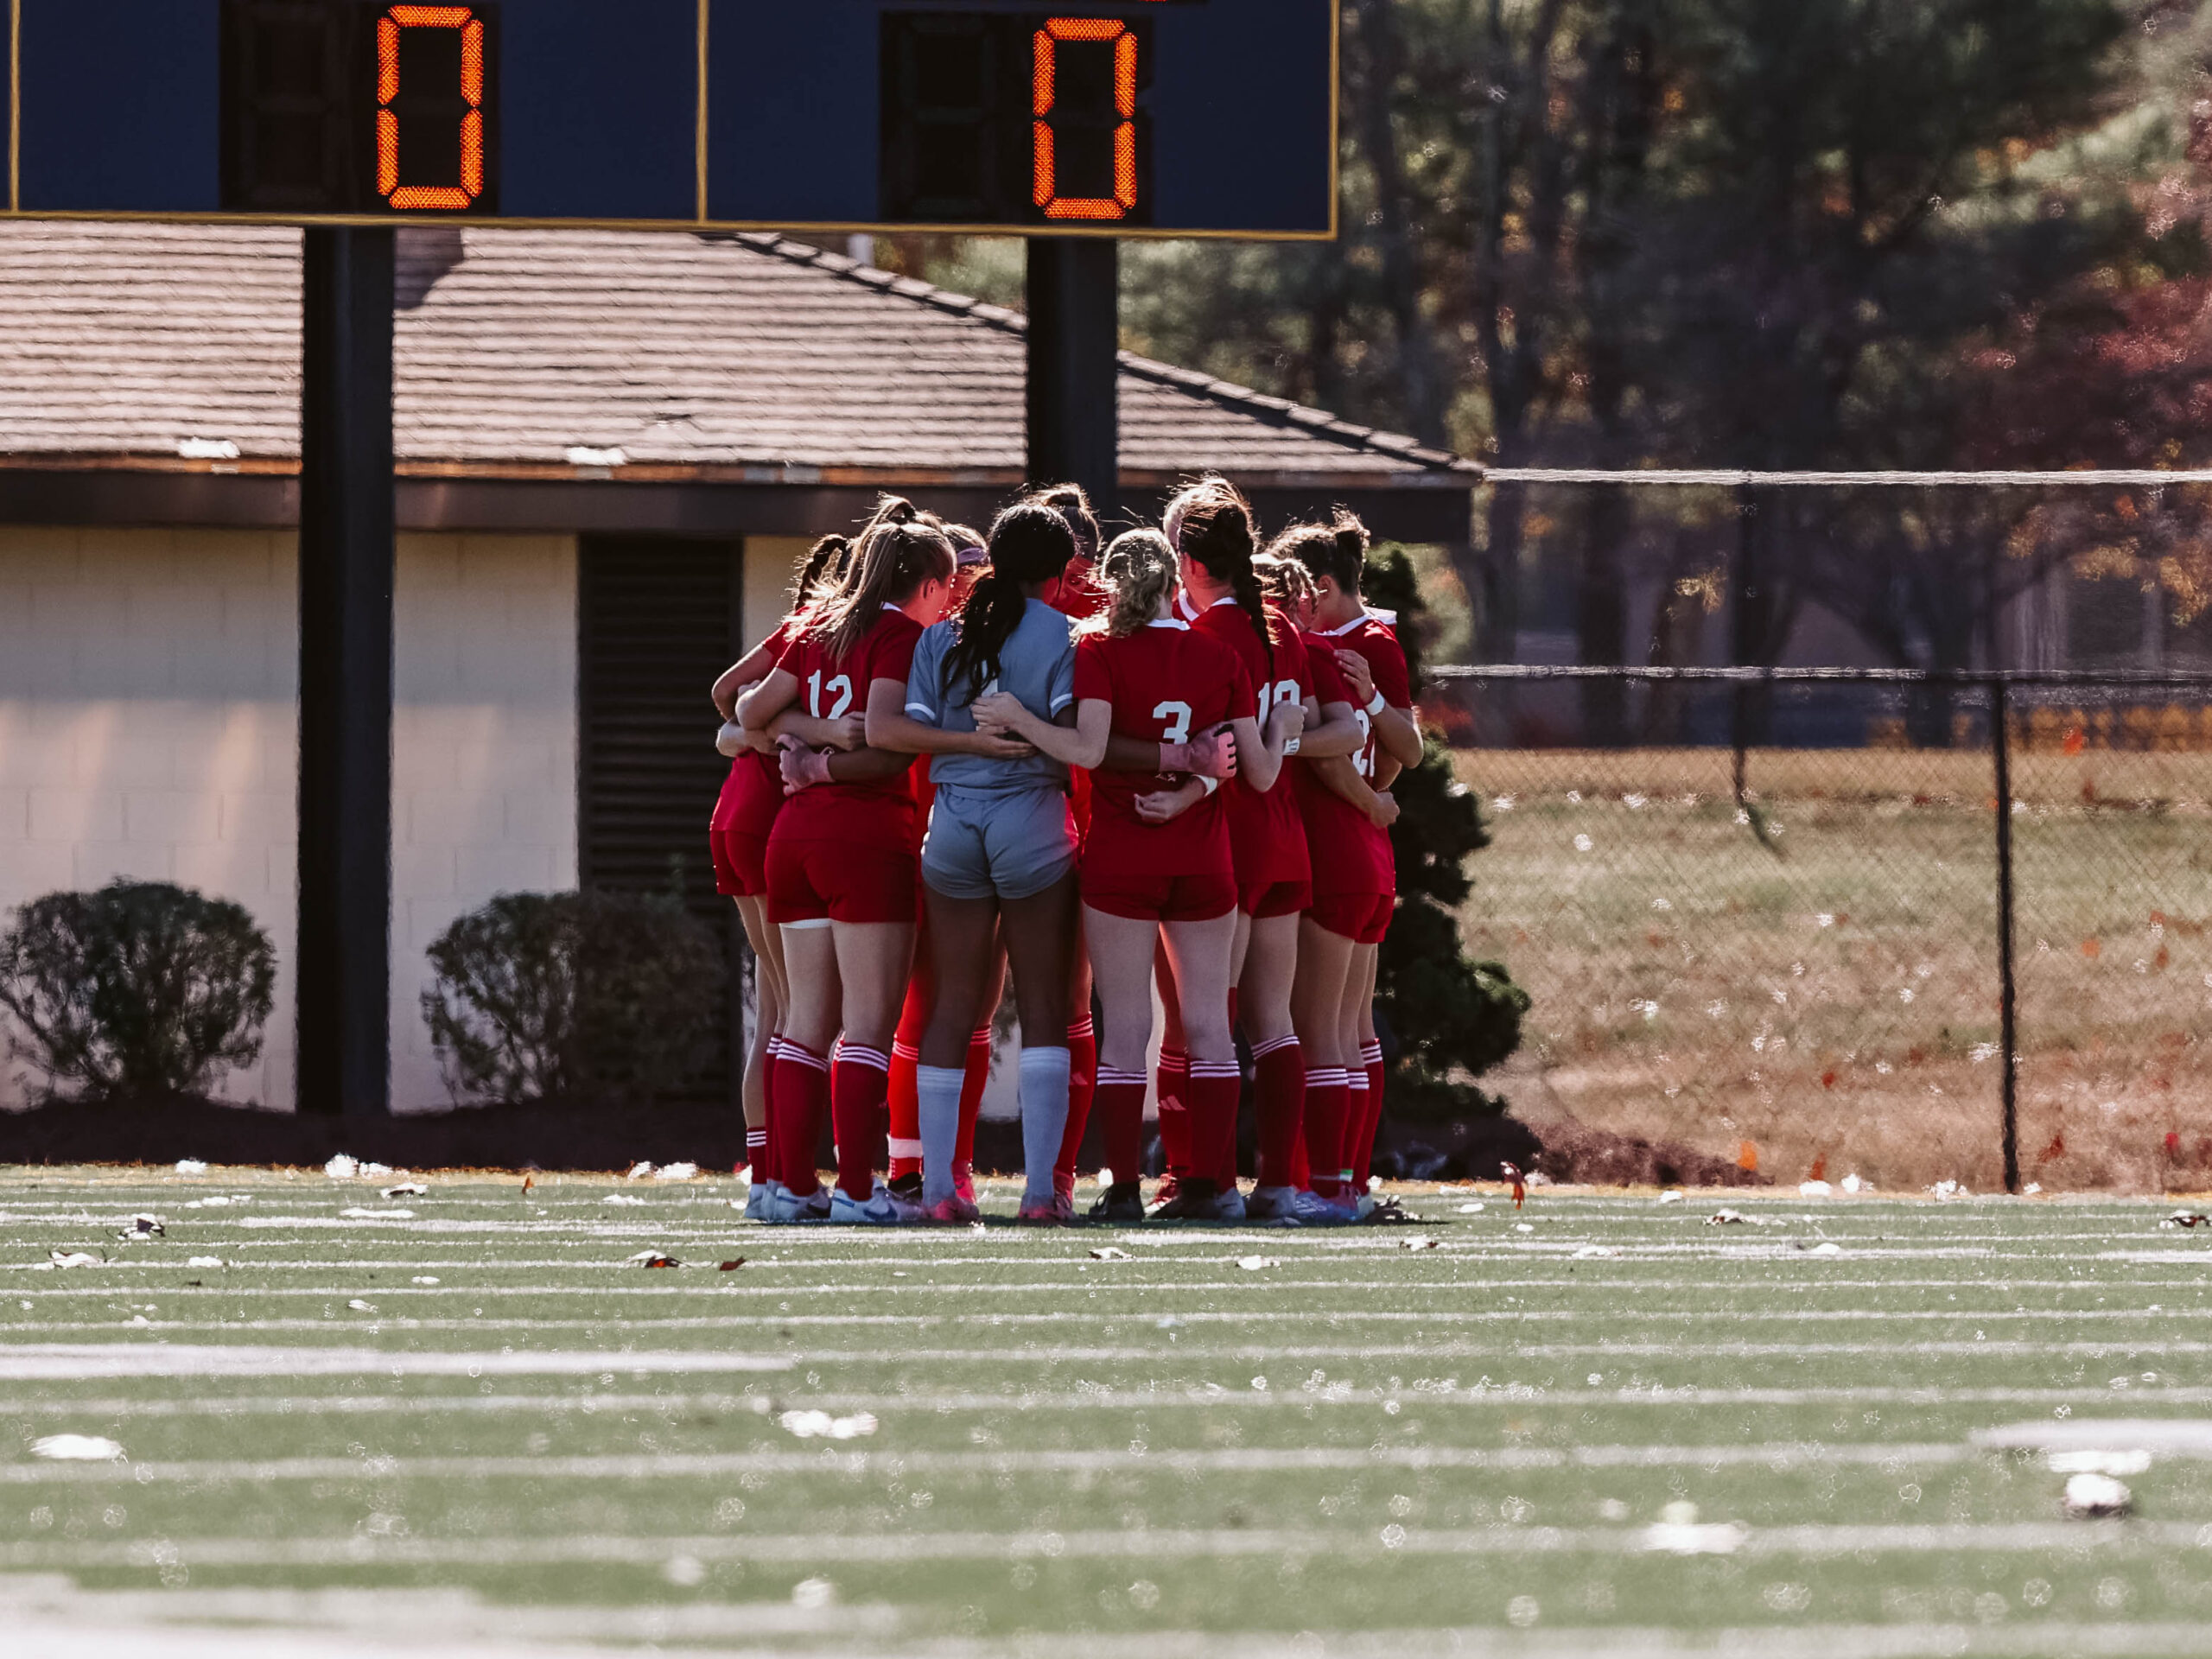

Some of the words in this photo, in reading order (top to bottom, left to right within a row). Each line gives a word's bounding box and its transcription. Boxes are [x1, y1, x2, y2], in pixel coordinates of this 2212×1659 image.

[377, 5, 484, 209] 0
[1033, 17, 1137, 219] 0
[807, 669, 853, 719] 12
[1153, 701, 1192, 745] 3
